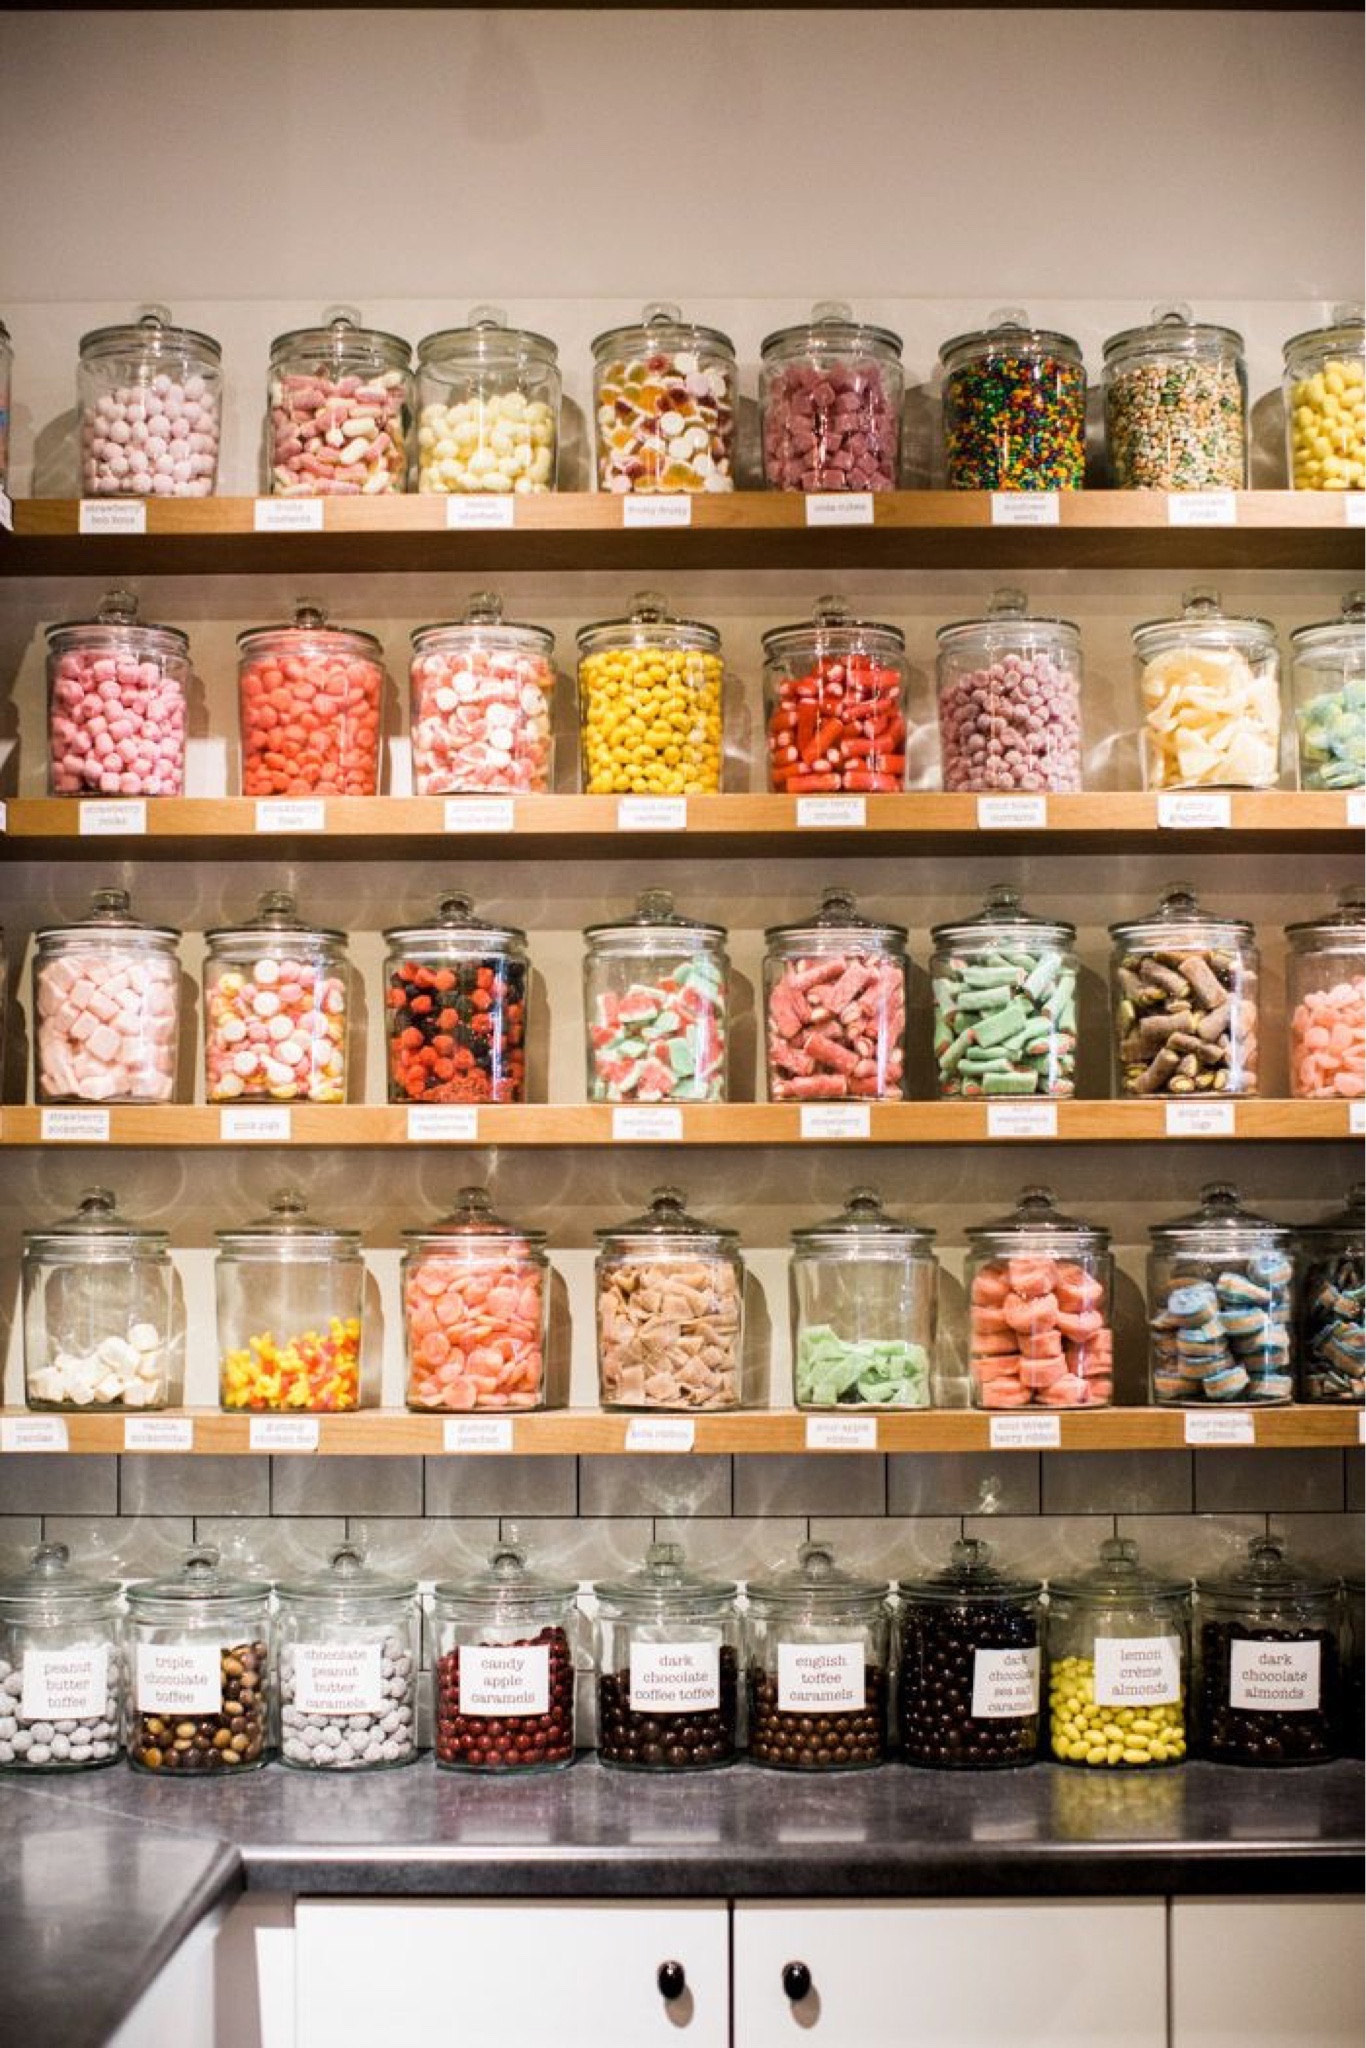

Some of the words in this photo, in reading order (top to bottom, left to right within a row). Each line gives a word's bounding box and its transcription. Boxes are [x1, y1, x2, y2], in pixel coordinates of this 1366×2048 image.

[303, 1649, 368, 1661] chocolate
[659, 1655, 693, 1667] dark
[1120, 1648, 1162, 1661] lemon
[1257, 1653, 1292, 1666] dark
[44, 1661, 92, 1676] peanut
[155, 1657, 194, 1670] triple
[481, 1658, 525, 1672] candy
[795, 1655, 847, 1669] english
[143, 1673, 208, 1685] chocolate
[311, 1667, 360, 1679] peanut
[643, 1671, 709, 1683] chocolate
[801, 1672, 842, 1684] toffee
[1241, 1669, 1308, 1682] chocolate
[46, 1679, 90, 1691] butter
[313, 1682, 355, 1693] butter
[482, 1676, 523, 1689] apple
[1111, 1681, 1169, 1696] almonds
[155, 1690, 194, 1703] toffee
[471, 1691, 535, 1704] caramels
[635, 1689, 676, 1701] coffee
[679, 1688, 716, 1700] toffee
[789, 1689, 854, 1702] caramels
[1244, 1687, 1305, 1700] almonds
[48, 1696, 86, 1708] toffee
[305, 1698, 367, 1709] caramels
